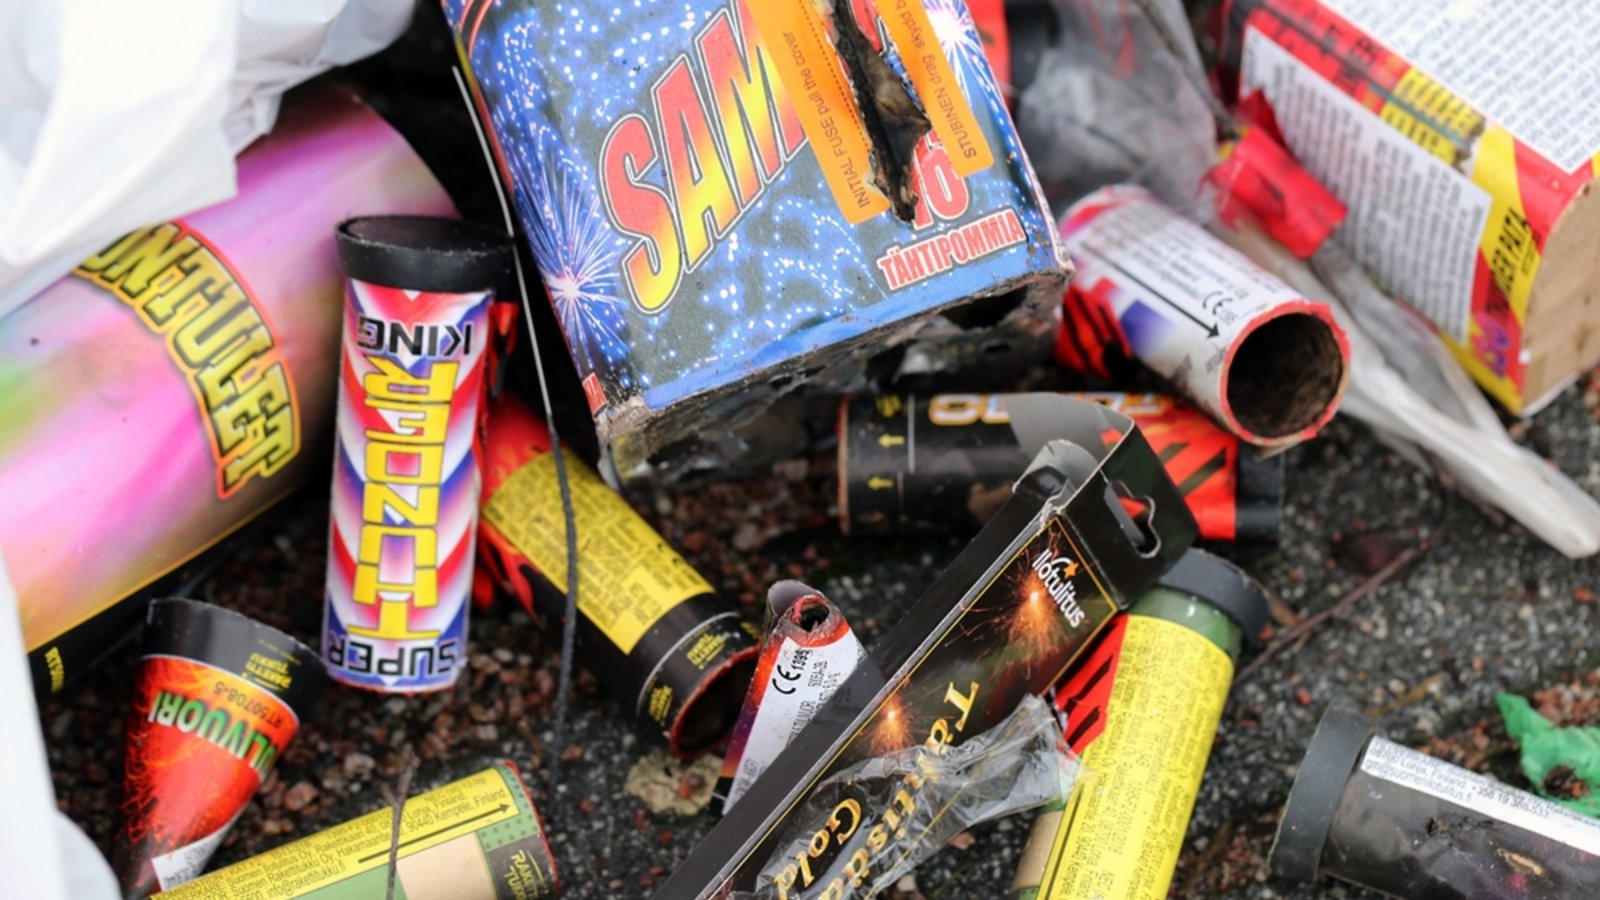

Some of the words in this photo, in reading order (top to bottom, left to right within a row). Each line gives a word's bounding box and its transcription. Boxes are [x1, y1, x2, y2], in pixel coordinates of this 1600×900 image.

[783, 31, 806, 66] cover
[901, 11, 925, 49] skydd
[800, 67, 816, 91] the
[922, 54, 942, 85] drag
[808, 90, 831, 116] pull
[934, 87, 977, 159] STUBINEN
[600, 0, 808, 313] SAM
[820, 116, 843, 158] FUSE
[840, 160, 871, 208] INITIAL
[877, 208, 1026, 291] TÄHTIPOMMIA
[357, 315, 473, 357] KING
[347, 354, 460, 641] THUNDER
[327, 633, 458, 678] SUPER
[774, 798, 862, 900] Gold
